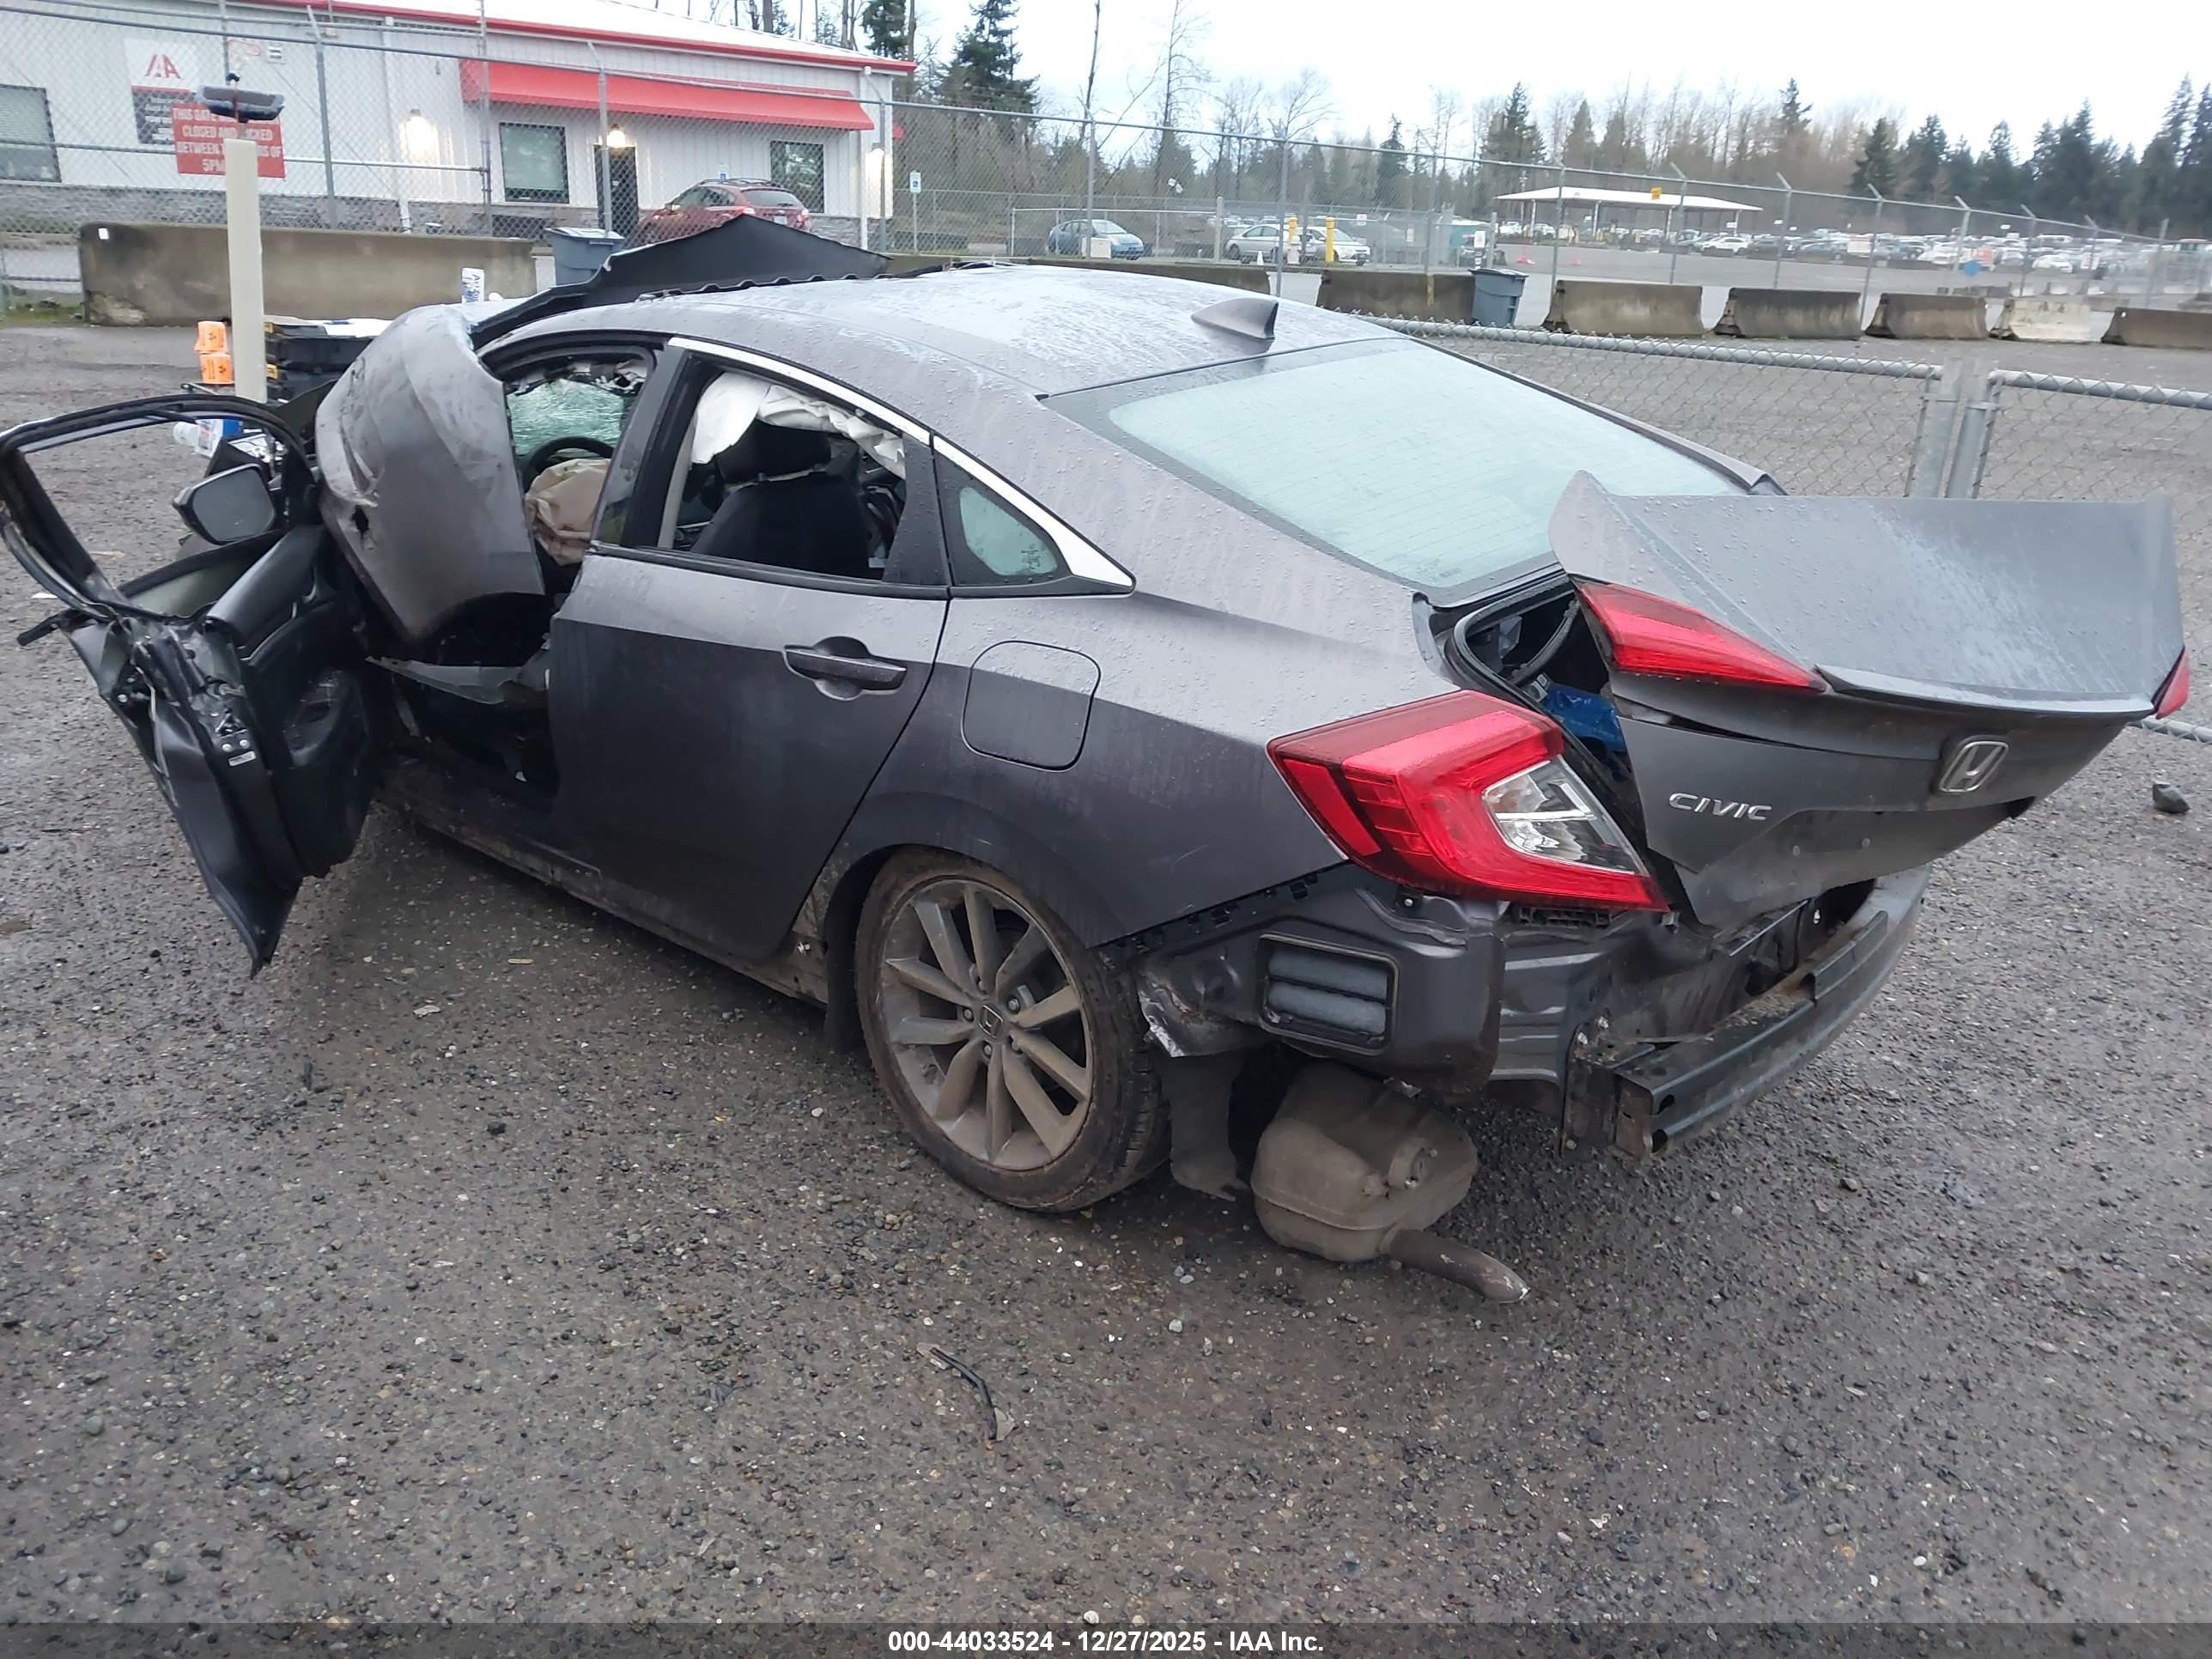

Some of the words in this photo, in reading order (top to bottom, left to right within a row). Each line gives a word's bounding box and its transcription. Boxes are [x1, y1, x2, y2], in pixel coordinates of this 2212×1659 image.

[182, 125, 217, 137] CLOSED
[176, 142, 220, 155] BETWEEN
[1669, 793, 1772, 820] CIVIC
